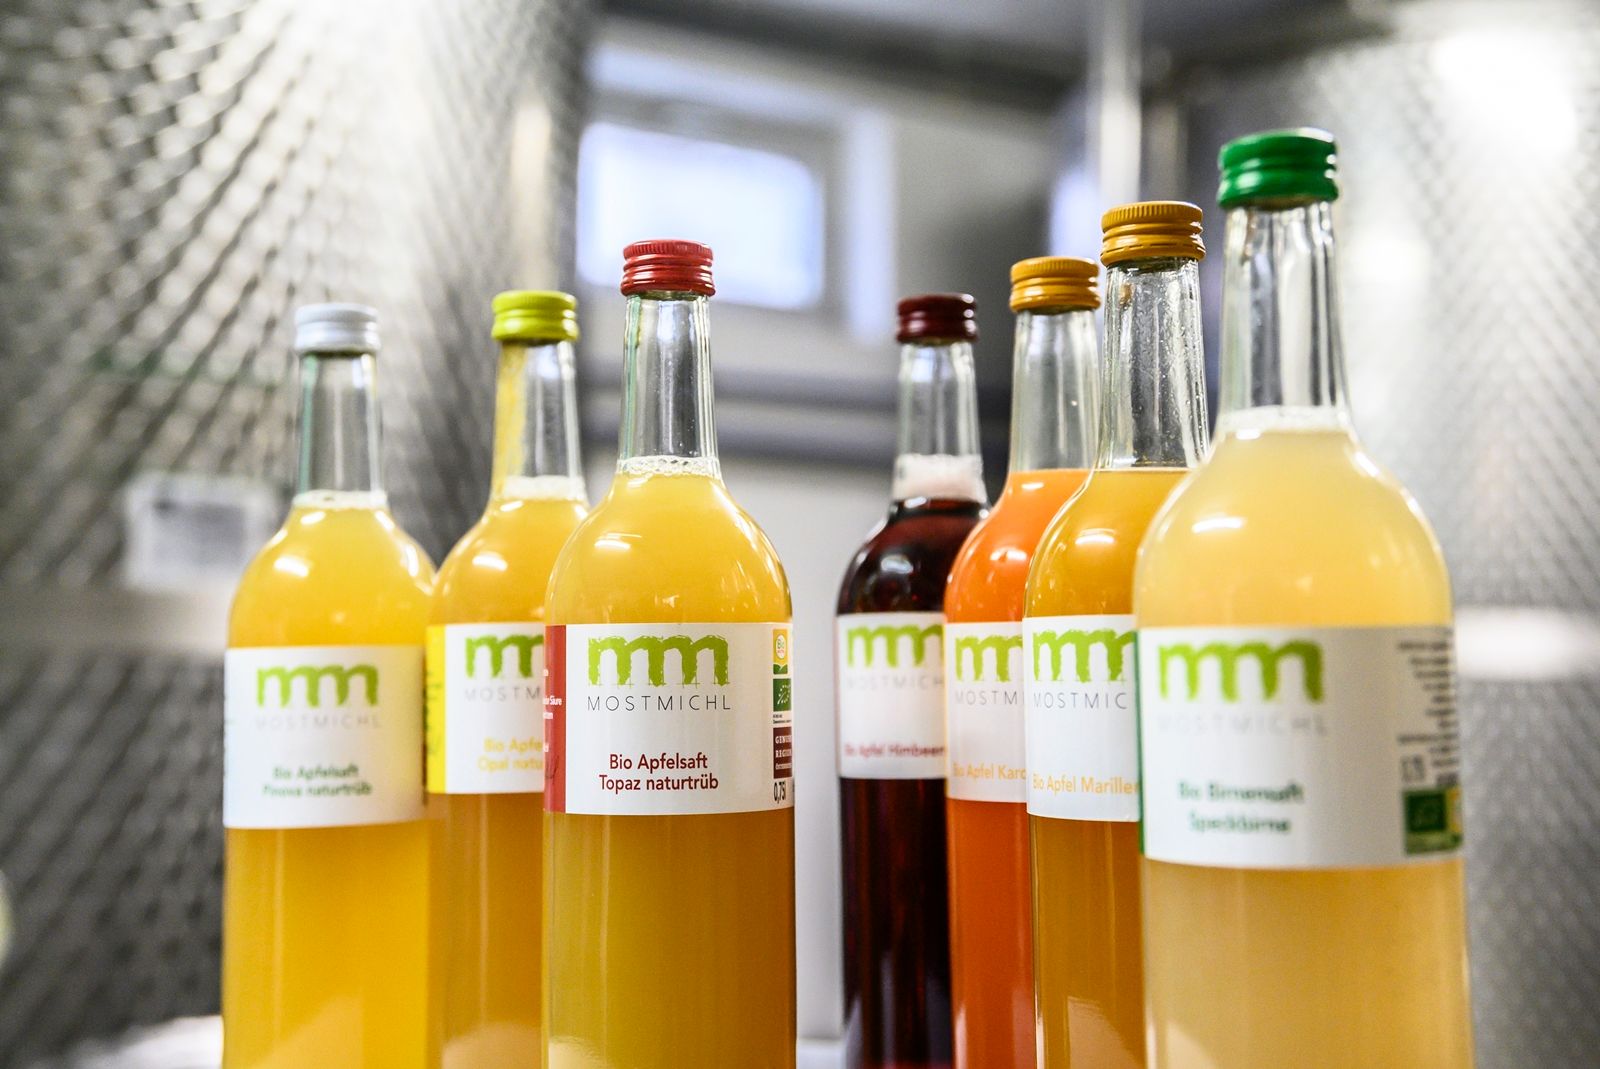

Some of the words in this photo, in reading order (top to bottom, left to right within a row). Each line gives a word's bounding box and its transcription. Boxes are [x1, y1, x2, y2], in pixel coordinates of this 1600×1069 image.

[847, 674, 944, 690] MOSTMICH
[465, 686, 541, 702] MOSTM
[587, 694, 731, 711] MOSTMICHL
[1033, 691, 1128, 710] MOSTMIC
[483, 736, 504, 752] Bio
[509, 736, 543, 755] Apfe
[273, 765, 291, 780] Bio
[297, 763, 359, 781] Apfelsaft
[512, 757, 544, 770] natu
[609, 753, 632, 770] Bio
[637, 752, 708, 774] Apfelsaft
[953, 762, 964, 776] Bio
[967, 761, 994, 781] Apfel
[998, 764, 1026, 779] Karo
[599, 774, 641, 794] Topaz
[646, 773, 719, 791] naturtrüb
[1033, 773, 1044, 790] Bio
[1047, 775, 1076, 796] Apfel
[1177, 781, 1200, 798] Bio
